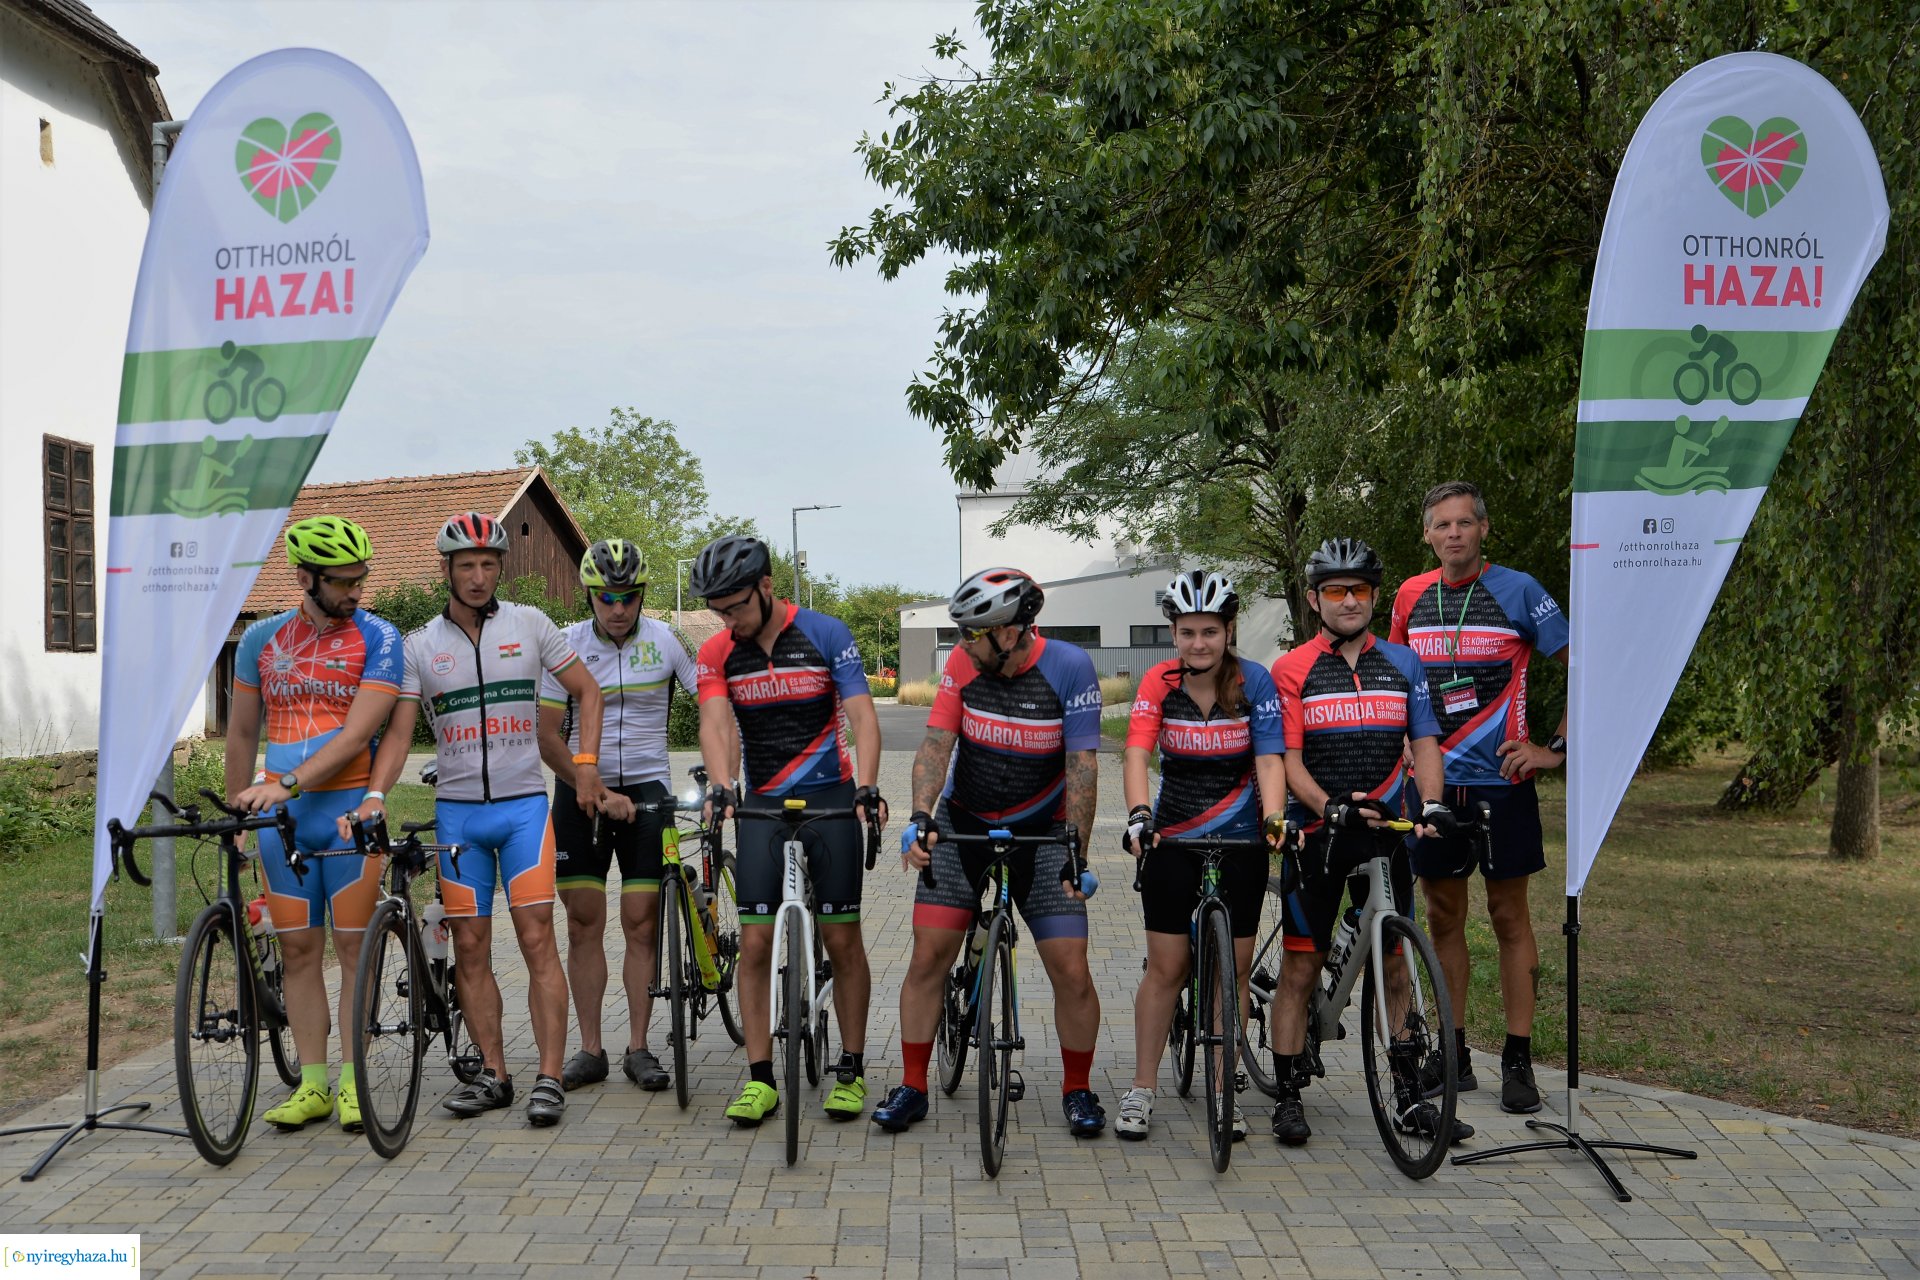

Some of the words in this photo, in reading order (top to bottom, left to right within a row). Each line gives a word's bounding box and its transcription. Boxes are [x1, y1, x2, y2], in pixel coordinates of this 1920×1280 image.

[215, 233, 356, 271] OTTHONRÓL
[1682, 232, 1824, 259] OTTHONRÓL
[214, 268, 356, 322] HAZA!
[1684, 264, 1824, 309] HAZA!
[1618, 541, 1700, 553] /otthonrolhaza
[147, 565, 221, 577] /otthonrolhaza
[1612, 557, 1703, 569] otthonrolhaza.hu
[268, 678, 359, 698] ViniBike
[449, 690, 498, 706] Groupma
[501, 686, 534, 697] Garancia
[1304, 699, 1376, 726] KISVÁRDA
[1375, 700, 1385, 710] ÉS
[500, 737, 532, 747] Team
[1024, 729, 1033, 740] ÉS
[1223, 729, 1231, 740] ÉS
